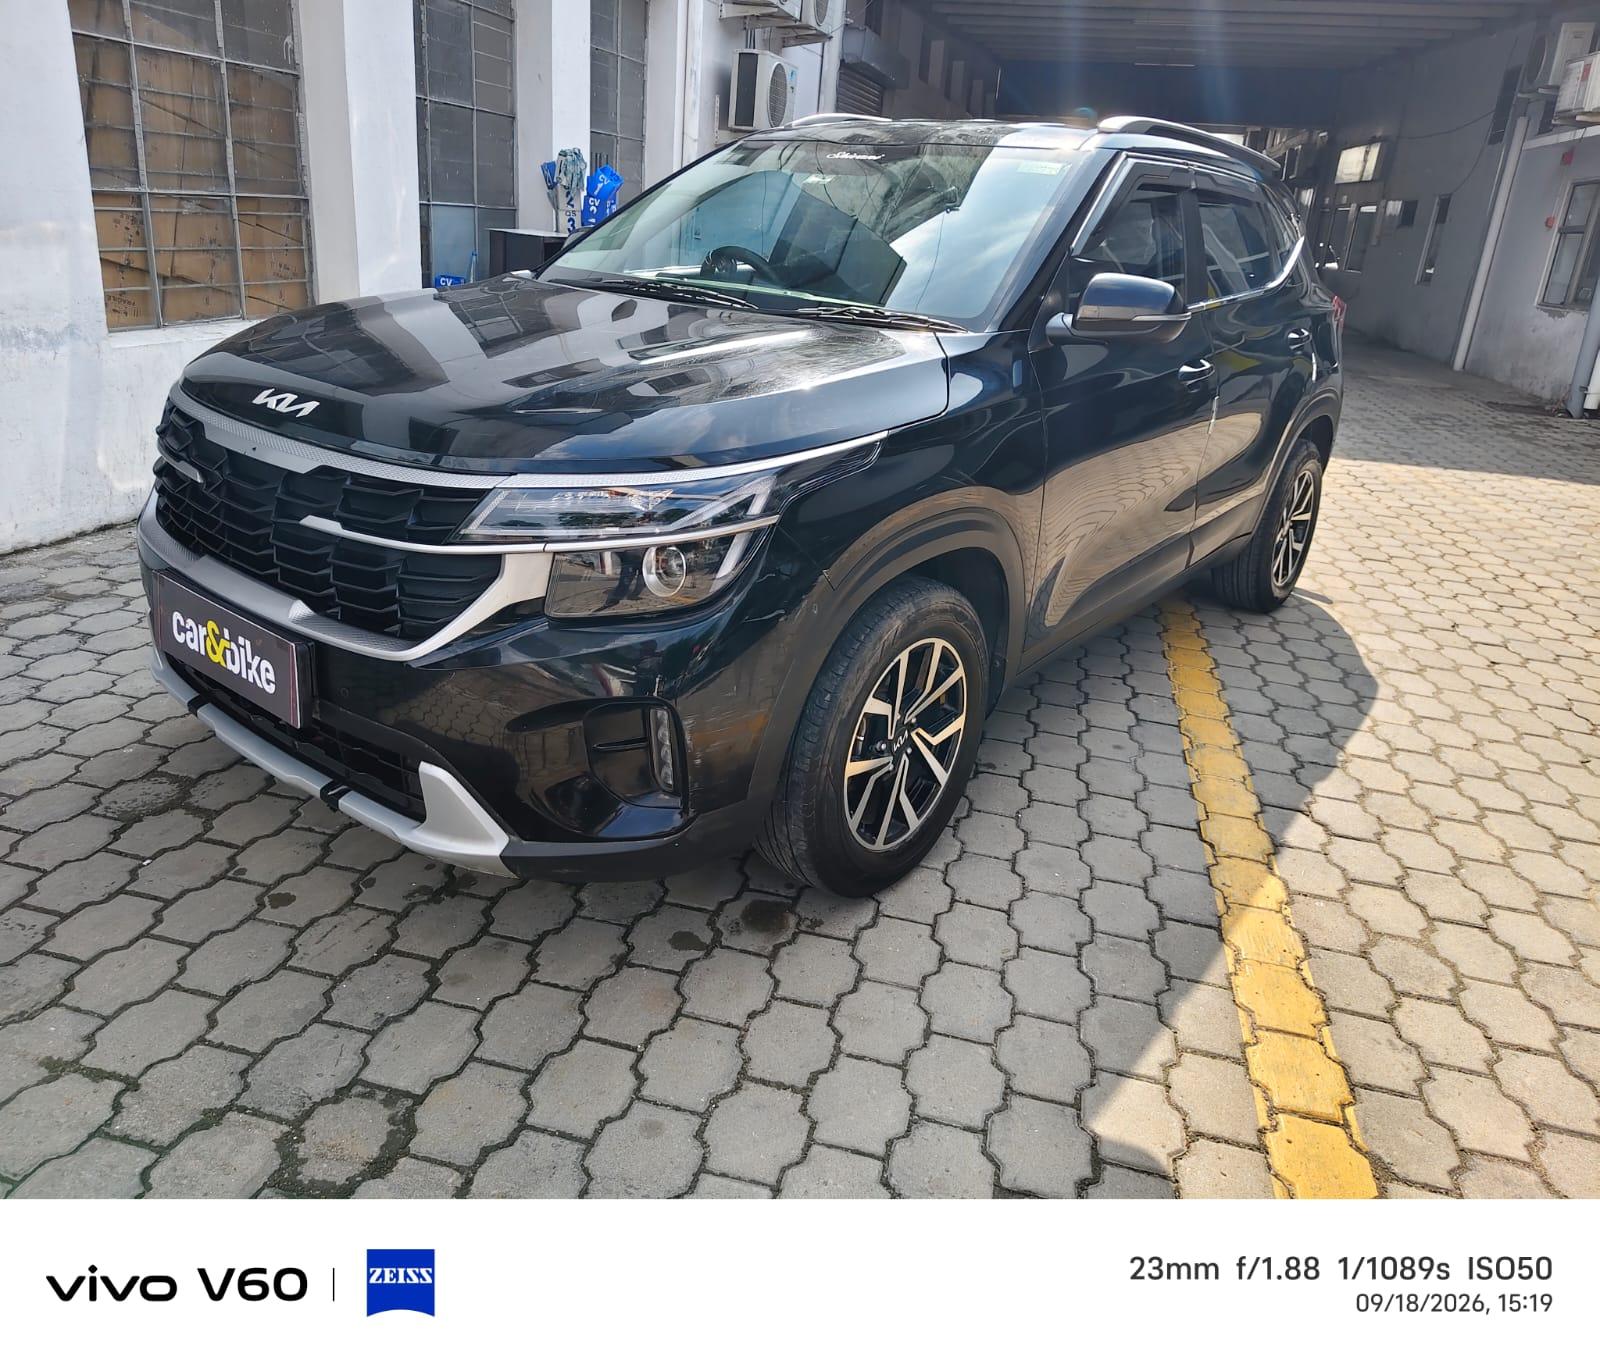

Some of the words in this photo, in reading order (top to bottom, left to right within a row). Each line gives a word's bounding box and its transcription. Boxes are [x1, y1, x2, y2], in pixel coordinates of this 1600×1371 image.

[589, 197, 600, 206] CV
[440, 277, 452, 286] CV
[172, 611, 276, 694] car&bike
